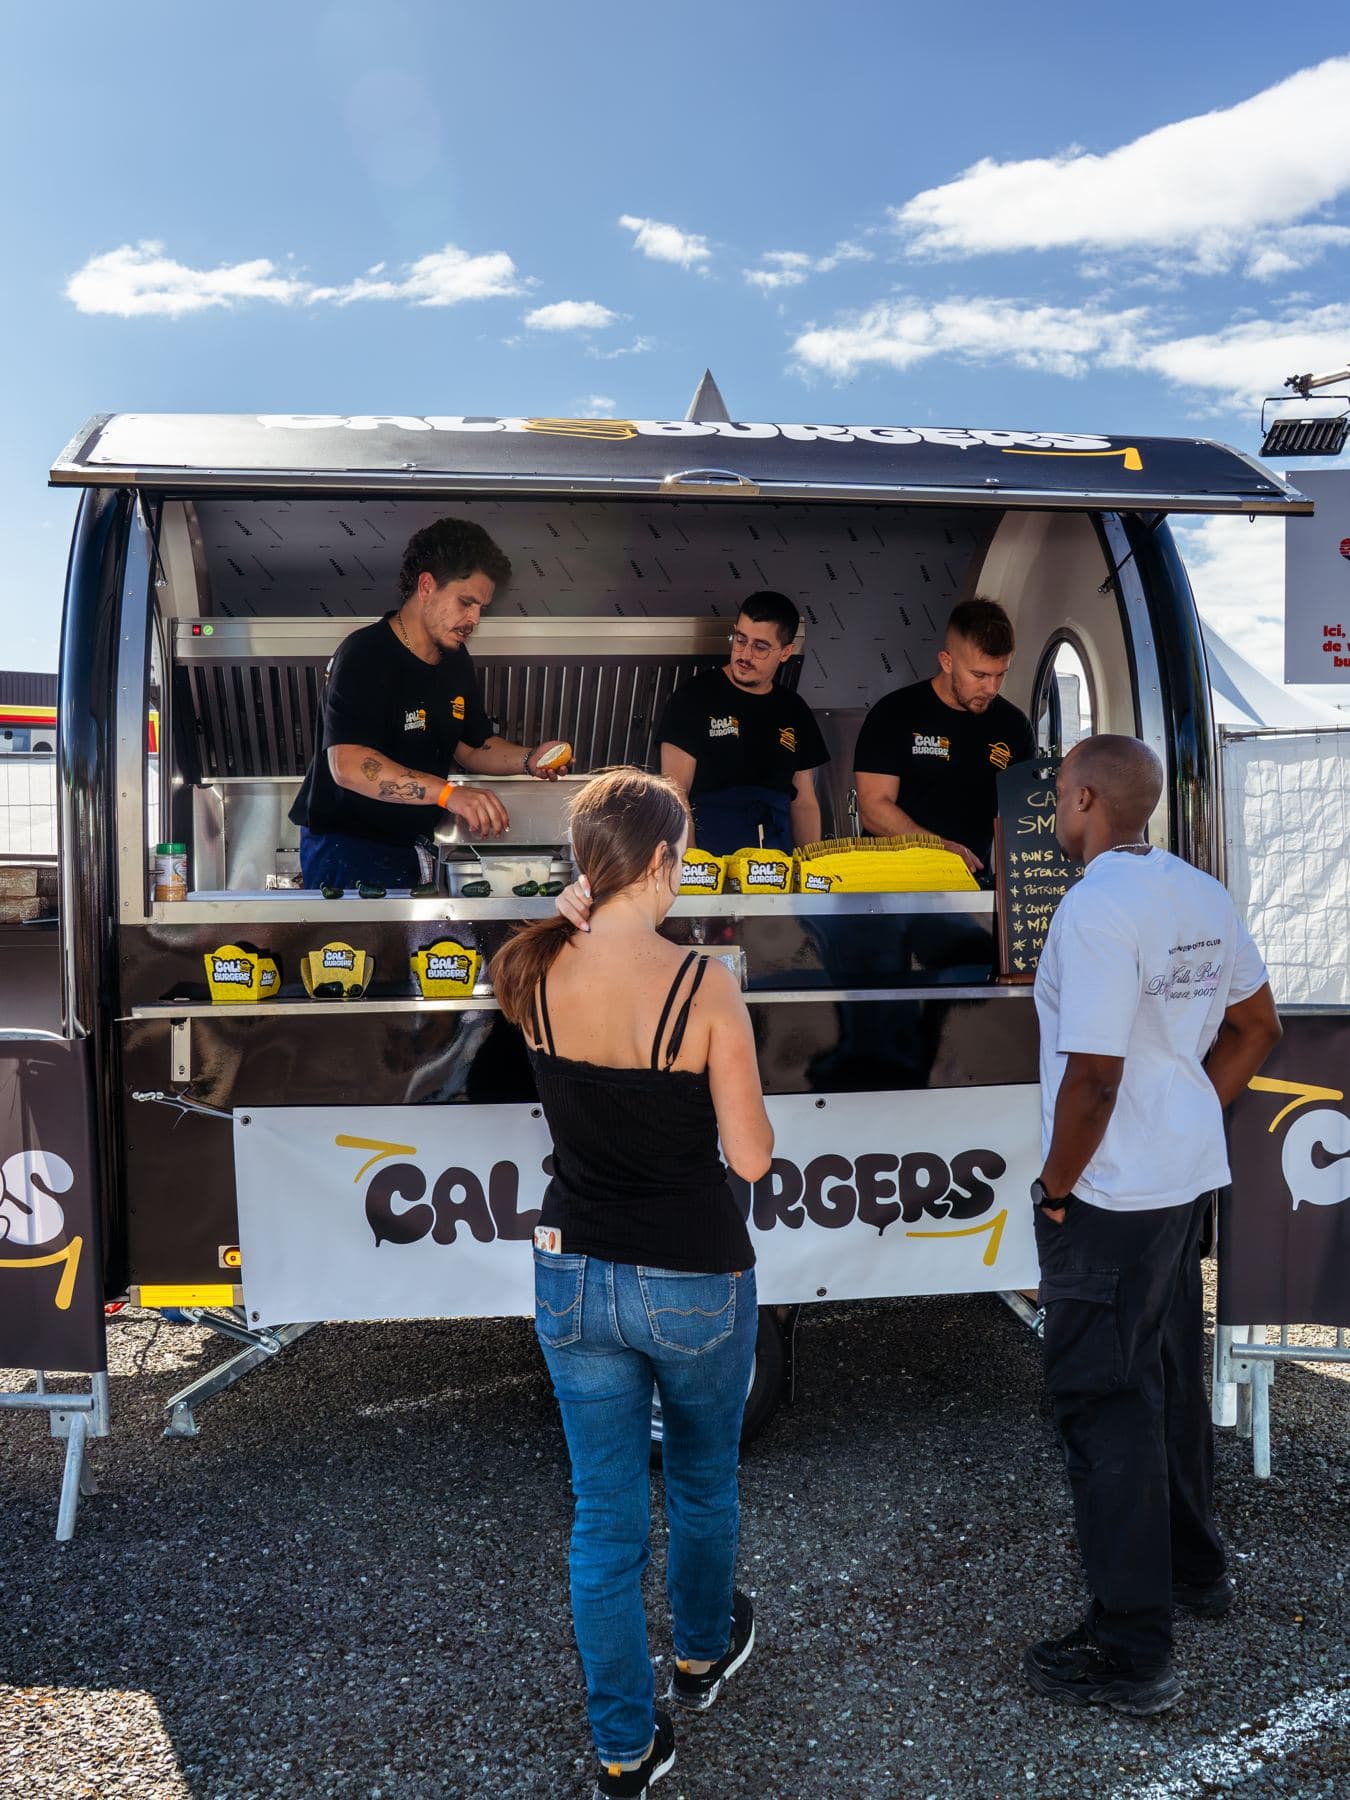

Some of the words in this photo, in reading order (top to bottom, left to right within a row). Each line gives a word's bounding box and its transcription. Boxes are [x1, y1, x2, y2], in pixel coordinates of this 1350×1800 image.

[636, 421, 1112, 450] BURGERS
[1323, 624, 1346, 638] Ici,
[1322, 640, 1342, 652] de
[1333, 655, 1350, 667] bu
[1027, 790, 1056, 807] CA
[1016, 813, 1056, 834] SM
[748, 875, 784, 885] BURGERS
[213, 972, 250, 983] BURGERS
[428, 968, 467, 979] BURGERS
[365, 1160, 555, 1248] CAL
[727, 1149, 1007, 1237] RGERS
